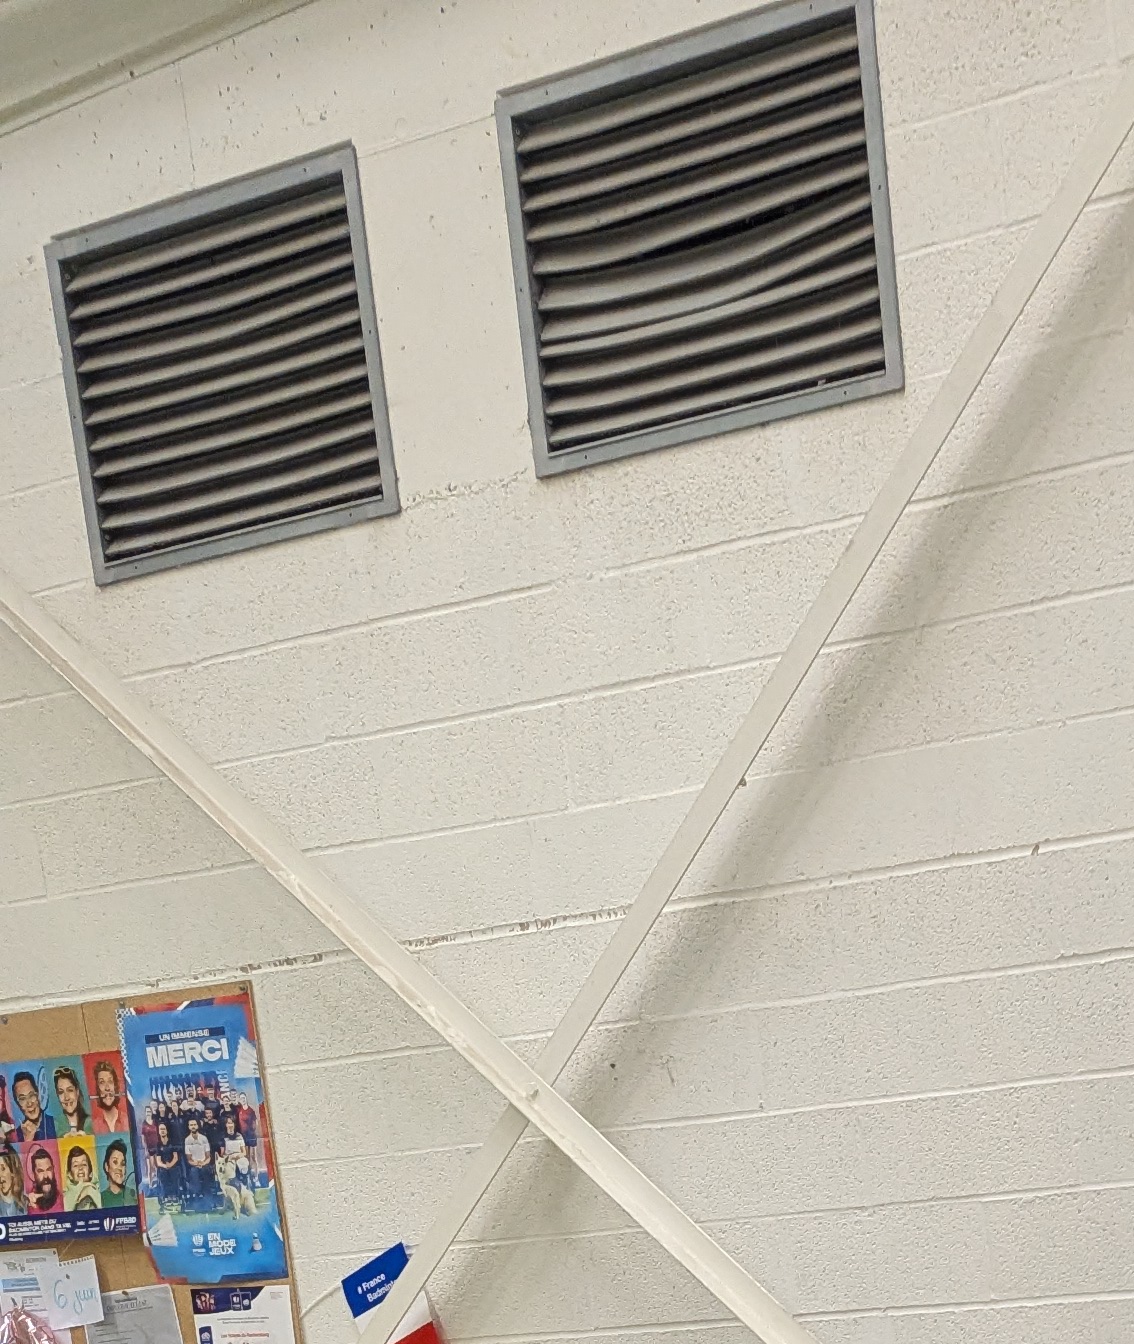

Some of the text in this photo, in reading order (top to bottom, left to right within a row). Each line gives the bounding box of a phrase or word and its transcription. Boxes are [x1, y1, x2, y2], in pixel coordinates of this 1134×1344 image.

[146, 1038, 230, 1069] MERCI
[208, 1247, 235, 1256] JEUX
[361, 1273, 386, 1291] France
[53, 1279, 68, 1310] 6
